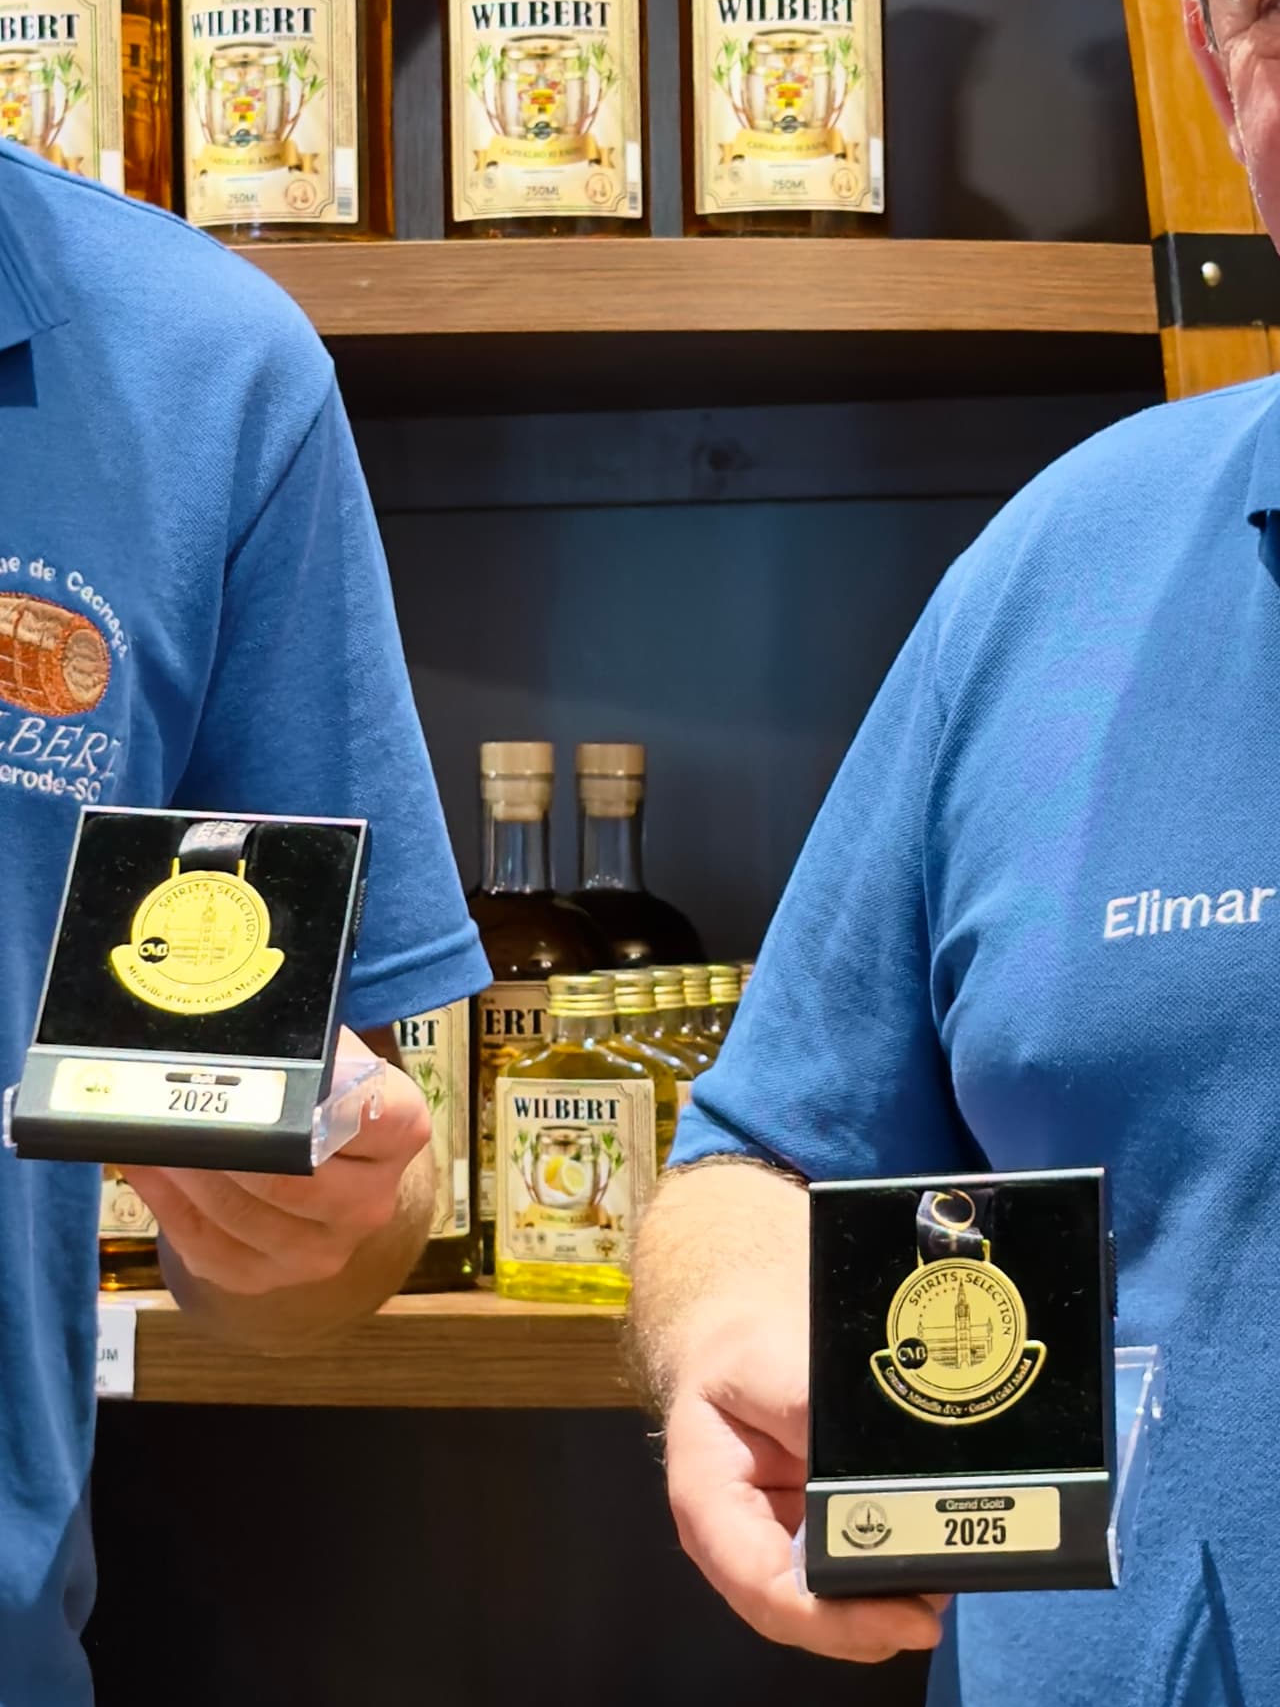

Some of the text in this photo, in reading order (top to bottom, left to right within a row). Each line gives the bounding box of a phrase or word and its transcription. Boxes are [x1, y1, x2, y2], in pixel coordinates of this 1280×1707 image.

[191, 7, 317, 38] WILBERT
[471, 0, 612, 30] WILBERT
[29, 558, 57, 582] de
[158, 883, 257, 943] SPIRITS SELECTION
[1103, 882, 1276, 941] Elimar
[168, 1088, 231, 1114] 2025
[514, 1096, 621, 1121] WILBERT
[908, 1271, 1013, 1336] SPIRITS SELECTION
[945, 1498, 1005, 1511] Grand Gold
[944, 1517, 1007, 1547] 2025
